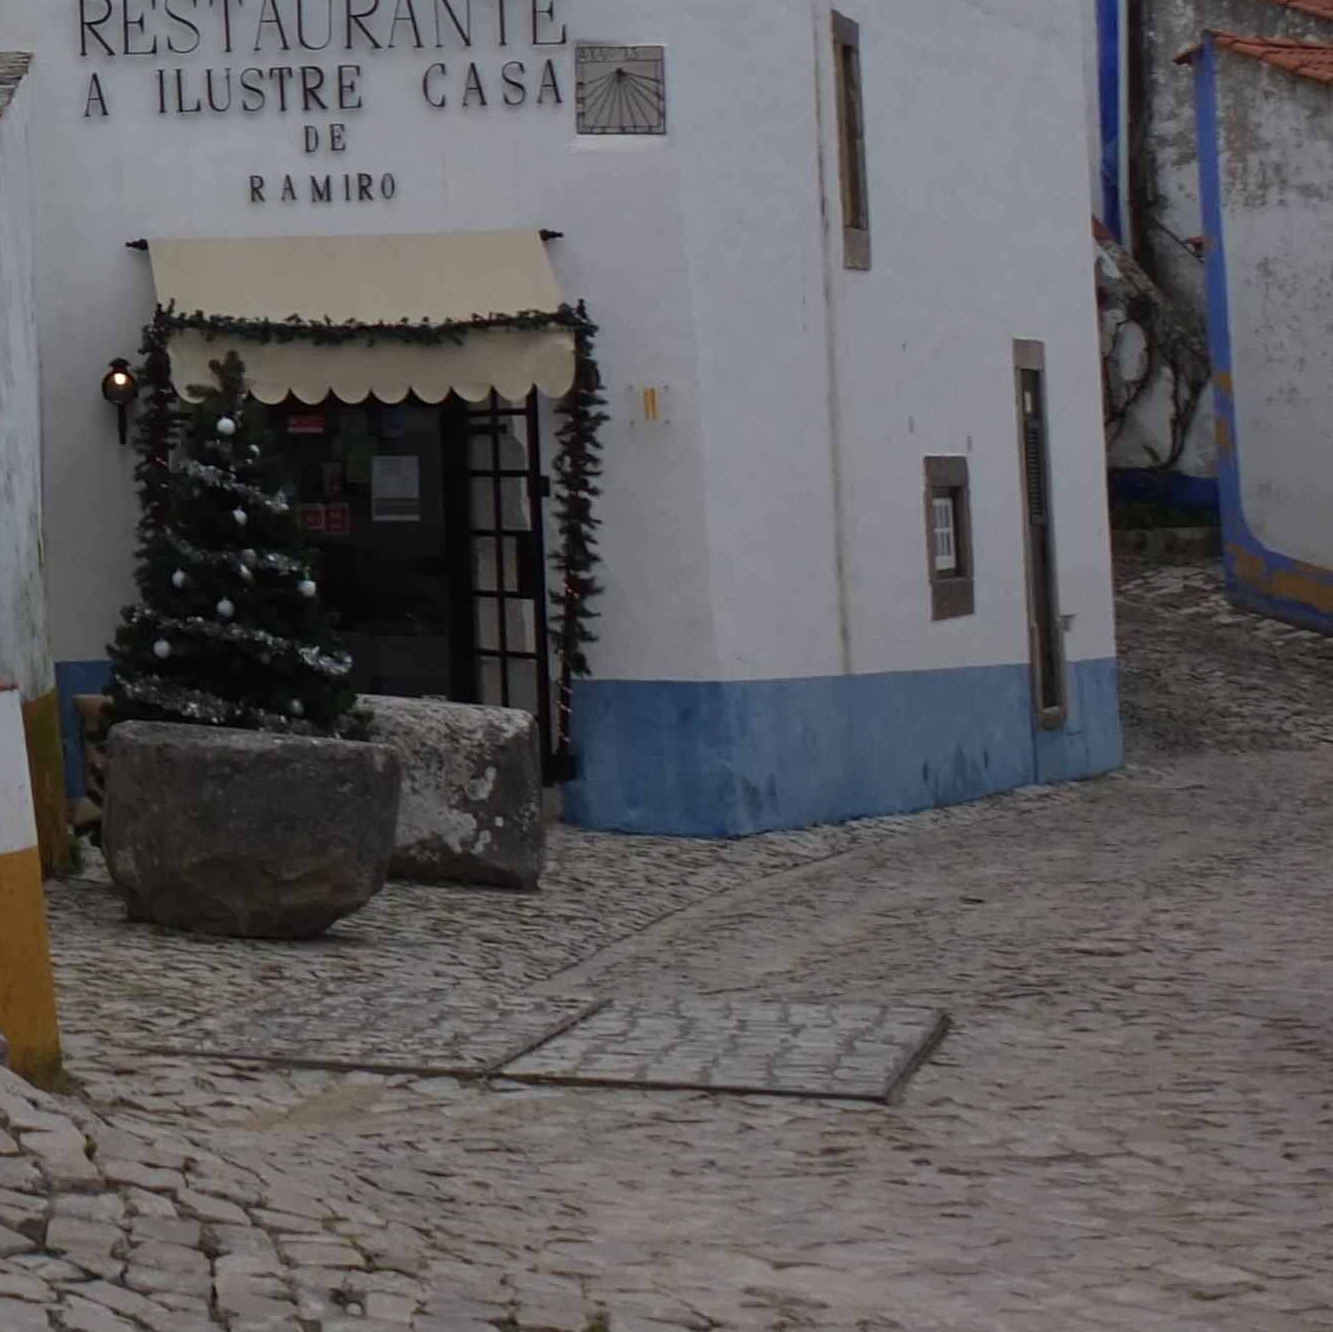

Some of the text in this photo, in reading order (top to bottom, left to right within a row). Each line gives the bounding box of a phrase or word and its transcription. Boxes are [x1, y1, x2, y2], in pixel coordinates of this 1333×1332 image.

[84, 58, 564, 117] A ILUSTRE CASA
[303, 123, 347, 154] DE
[249, 172, 397, 203] RAMIRO
